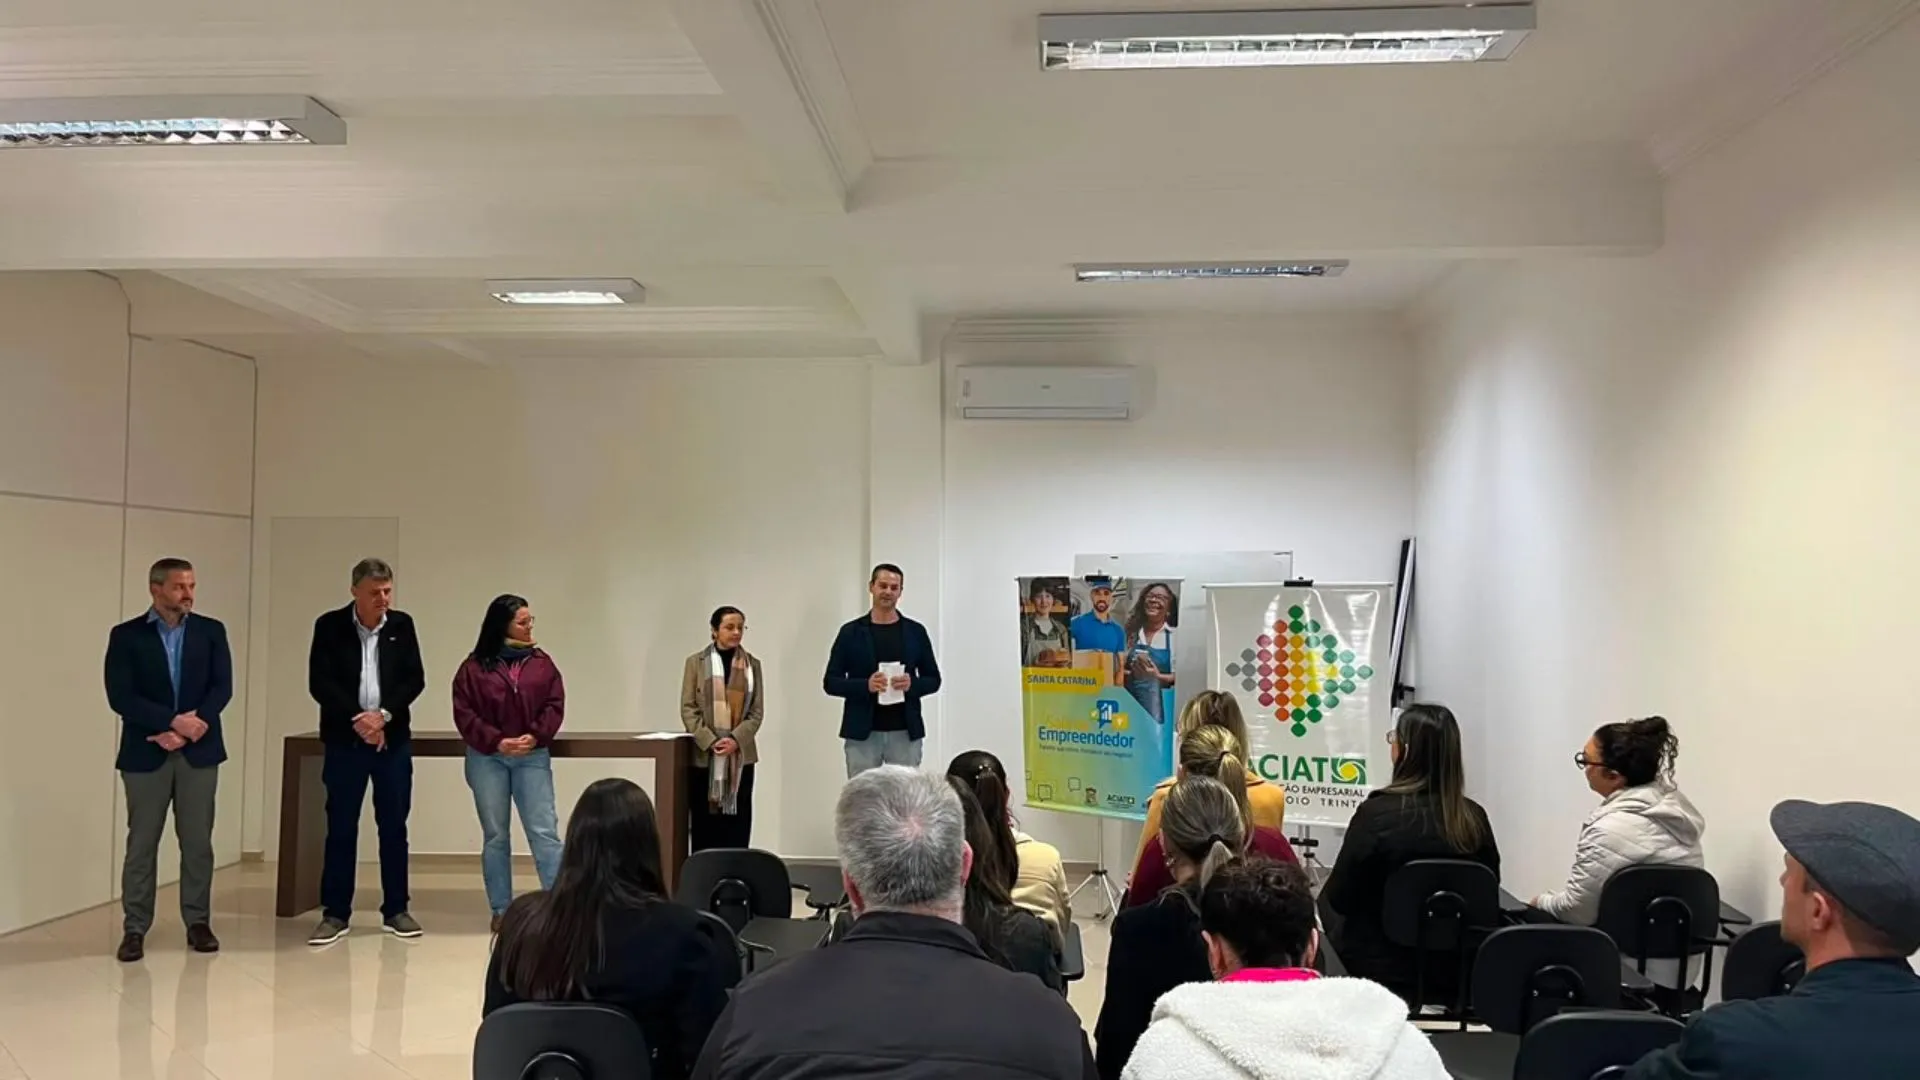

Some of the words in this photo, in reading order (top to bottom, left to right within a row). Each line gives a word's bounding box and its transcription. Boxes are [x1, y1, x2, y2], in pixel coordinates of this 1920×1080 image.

[1027, 674, 1055, 685] SANTA
[1057, 675, 1097, 687] CATARINA
[1038, 725, 1135, 749] Empreendedor
[1302, 785, 1365, 798] EMPRESARIAL
[1320, 797, 1358, 809] TRINT
